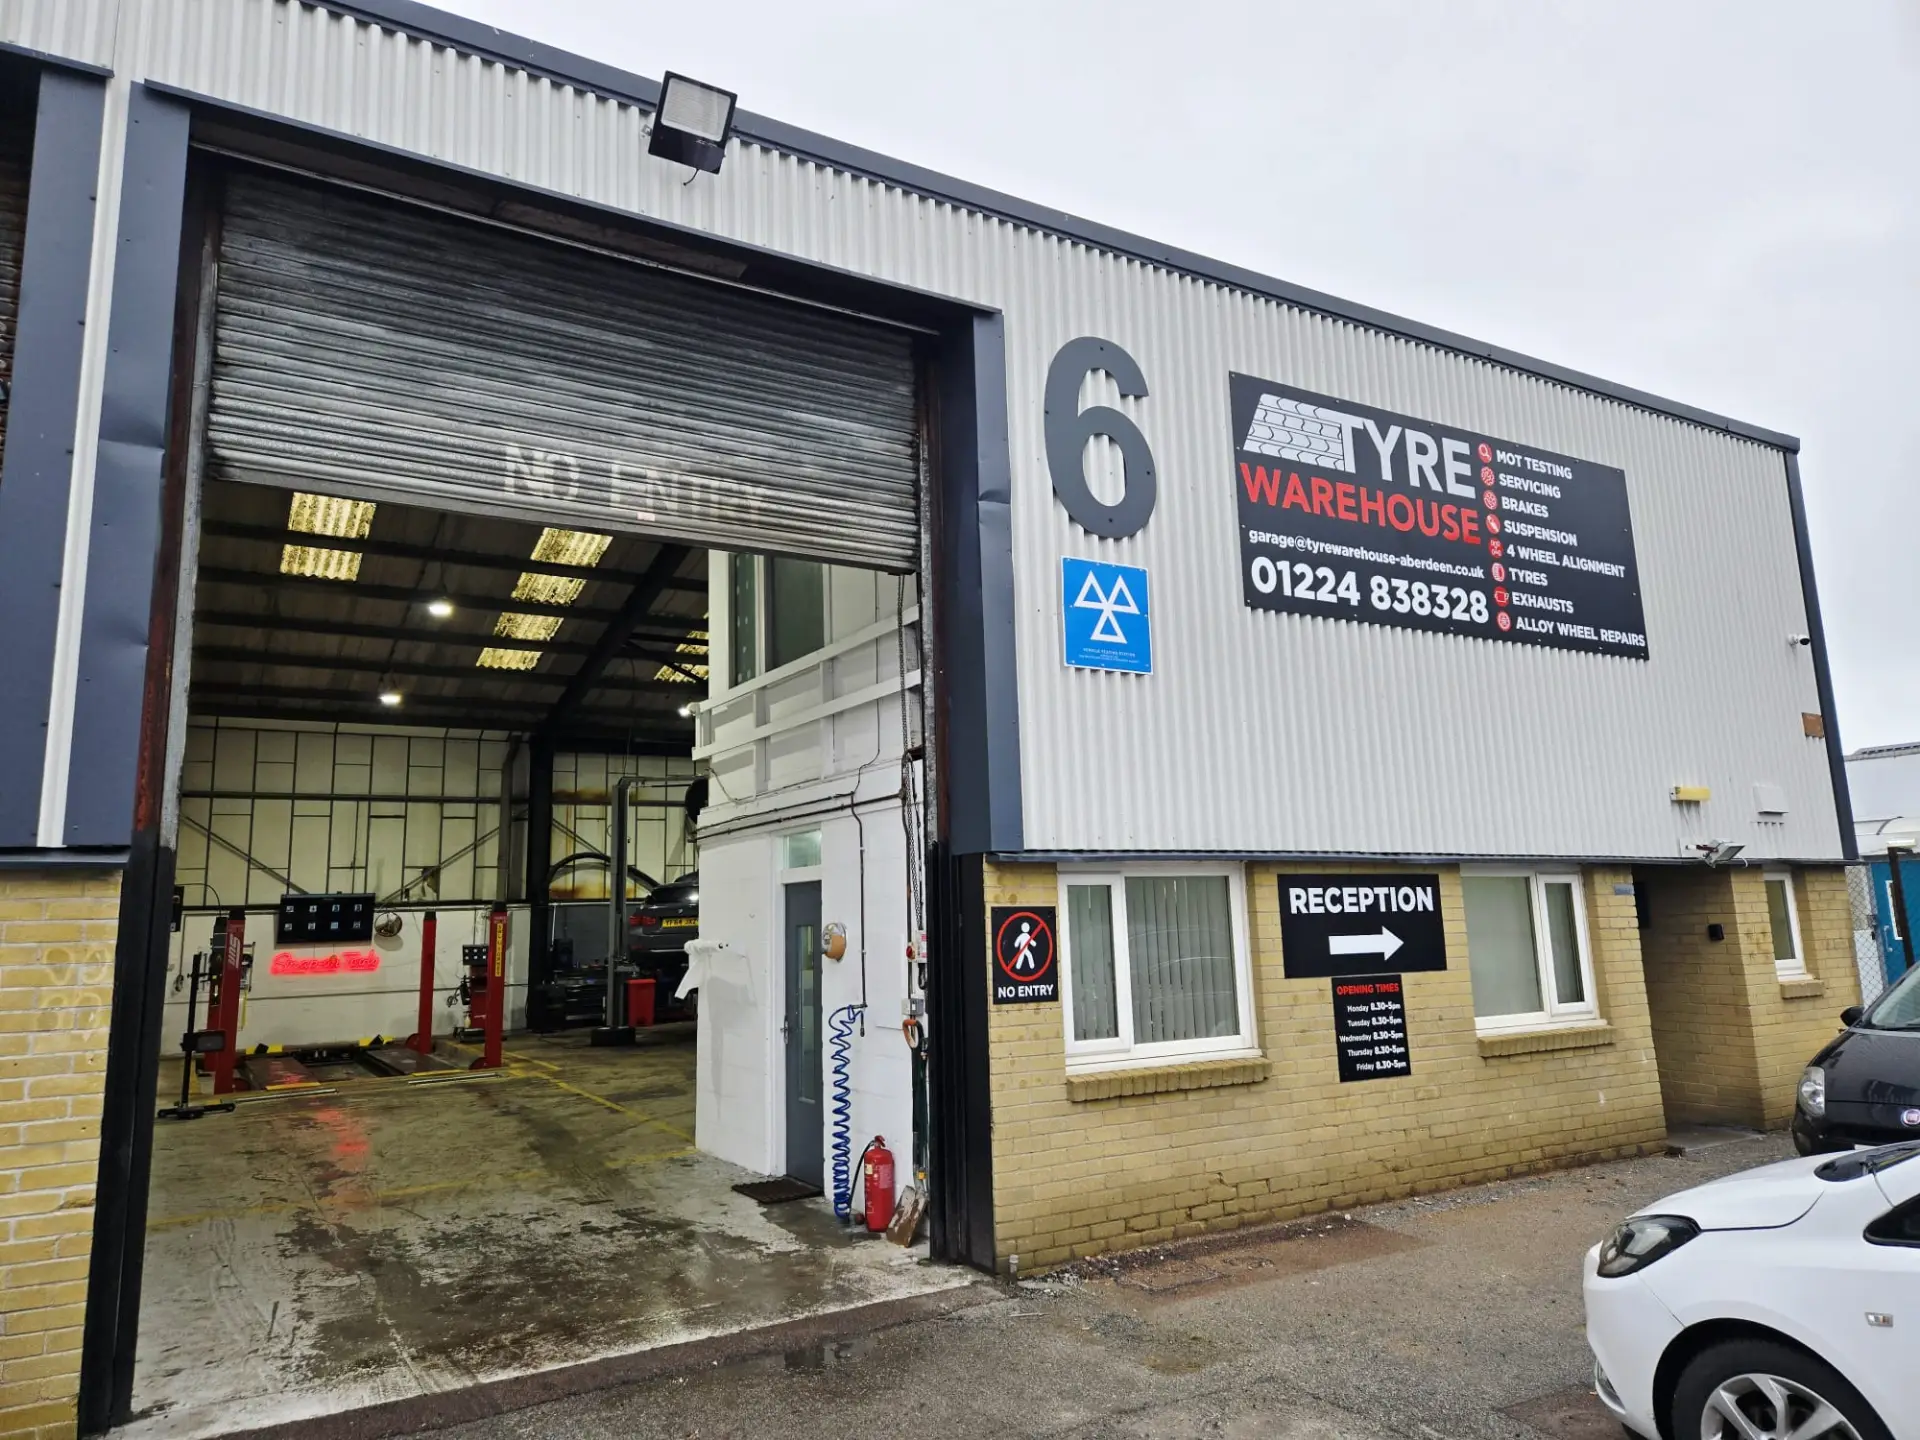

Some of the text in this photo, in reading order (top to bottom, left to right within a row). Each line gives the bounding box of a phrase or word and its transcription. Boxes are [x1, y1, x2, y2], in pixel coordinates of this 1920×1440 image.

[1044, 337, 1156, 539] 6
[1337, 413, 1476, 499] TYRE
[1496, 450, 1573, 479] MOT TESTING
[504, 443, 579, 503] NO
[1499, 473, 1561, 498] SERVICING
[1240, 462, 1481, 545] WAREHOUSE
[1501, 496, 1549, 518] BRAKES
[1504, 520, 1578, 546] SUSPENSION
[1248, 529, 1485, 579] garage@tyrewarehouse-aberdeen.co.uk
[1507, 544, 1626, 578] 4 WHEEL ALIGNMENT
[1509, 567, 1548, 586] TYRES
[1251, 556, 1489, 624] 01224 838328
[1512, 591, 1574, 614] EXHAUSTS
[1516, 616, 1646, 647] ALLOY WHEEL REPAIRS
[1288, 886, 1435, 915] RECEPTION
[997, 984, 1054, 998] NO ENTRY
[1336, 982, 1399, 995] OPENING TIMES
[1347, 1005, 1369, 1013] Monday
[1347, 1019, 1370, 1027] Tuesday
[1339, 1034, 1372, 1043] Wednesday
[1347, 1048, 1373, 1057] Thursday
[1356, 1062, 1374, 1071] Friday
